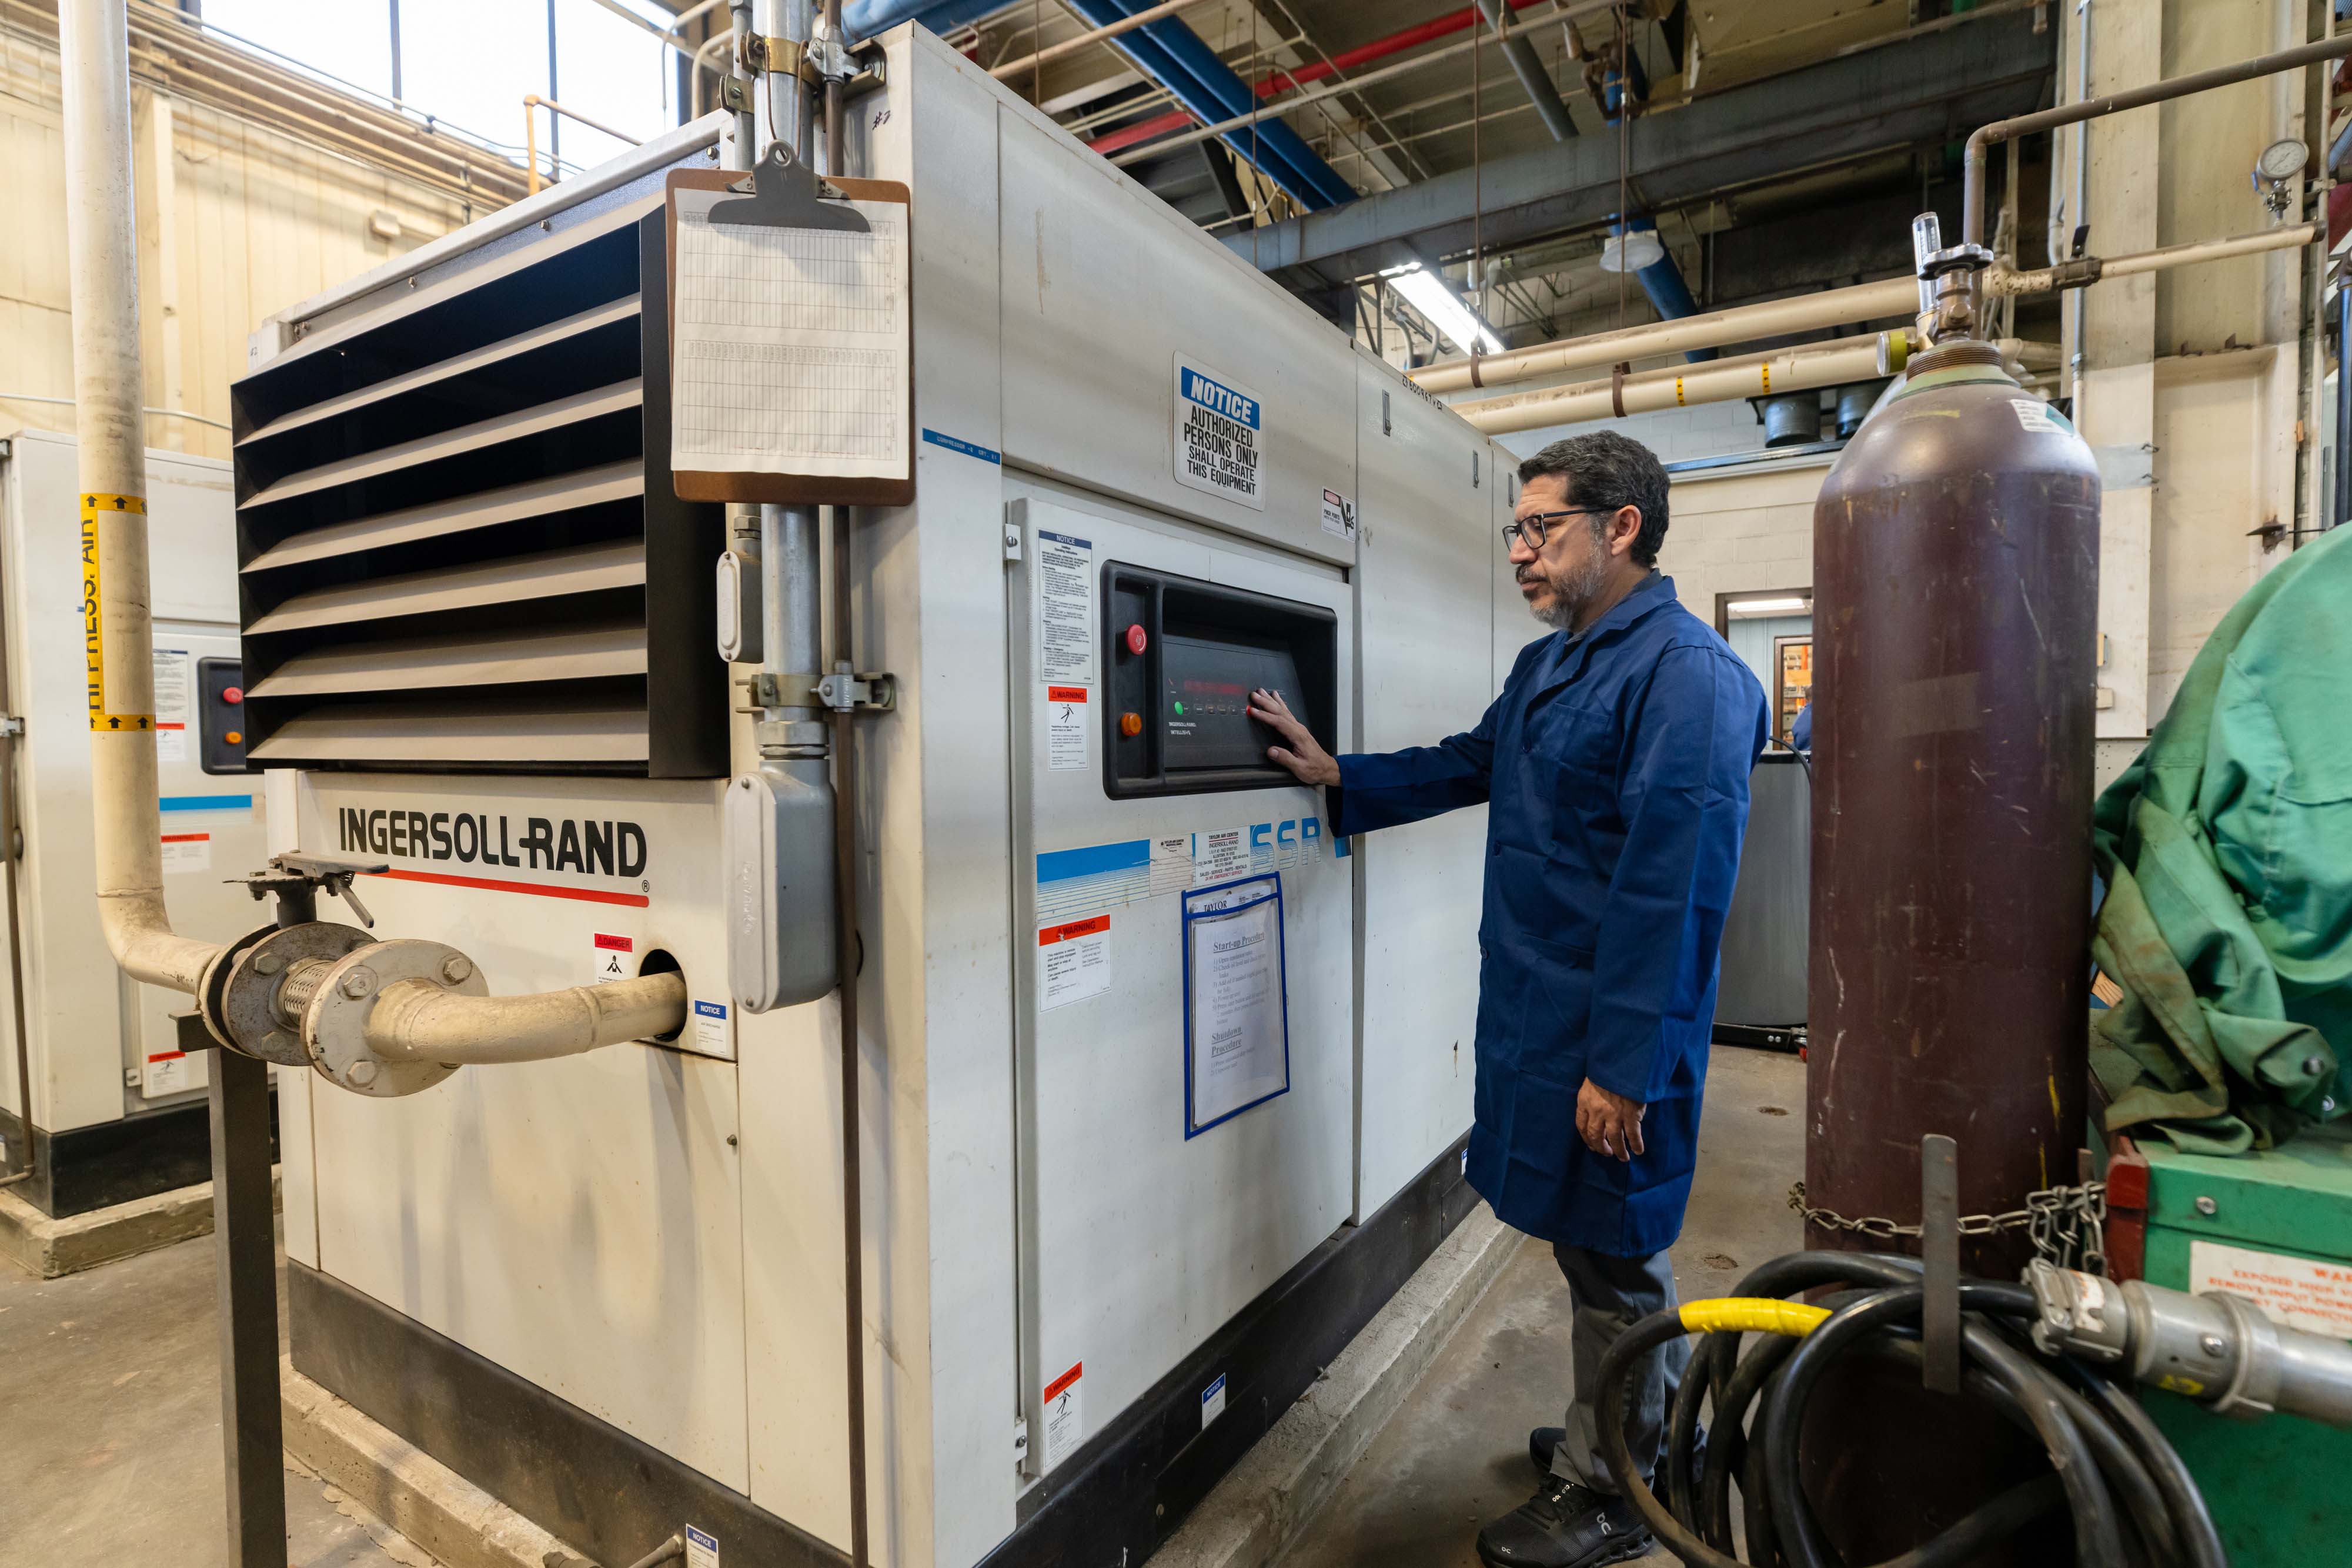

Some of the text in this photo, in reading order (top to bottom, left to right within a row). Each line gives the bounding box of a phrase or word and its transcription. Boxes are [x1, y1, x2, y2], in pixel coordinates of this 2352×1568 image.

[1191, 375, 1252, 423] NOTICE
[1191, 405, 1252, 448] AUTHORIZED
[1184, 422, 1258, 469] PERSONS ONLY
[1189, 446, 1254, 482] SHALL OPERATE
[1187, 459, 1256, 496] THIS EQUIPMENT
[1057, 534, 1075, 544] NOTICE
[1057, 691, 1084, 700] WARNING
[339, 807, 647, 878] INGERSOLL-RAND
[1251, 817, 1322, 875] SSR
[1204, 900, 1227, 912] TAYLOR
[1063, 921, 1095, 936] WARNING
[603, 937, 629, 948] DANGER
[1213, 931, 1265, 951] Start-up Procedure
[700, 1005, 720, 1015] NOTICE
[1212, 1027, 1241, 1041] Shutdown
[1212, 1039, 1241, 1055] Procedure
[2209, 1276, 2263, 1295] REMOVE
[2233, 1269, 2293, 1287] EXPOSED
[1053, 1367, 1080, 1392] WARNING
[1207, 1380, 1221, 1398] NOTICE
[693, 1532, 711, 1548] NOTICE
